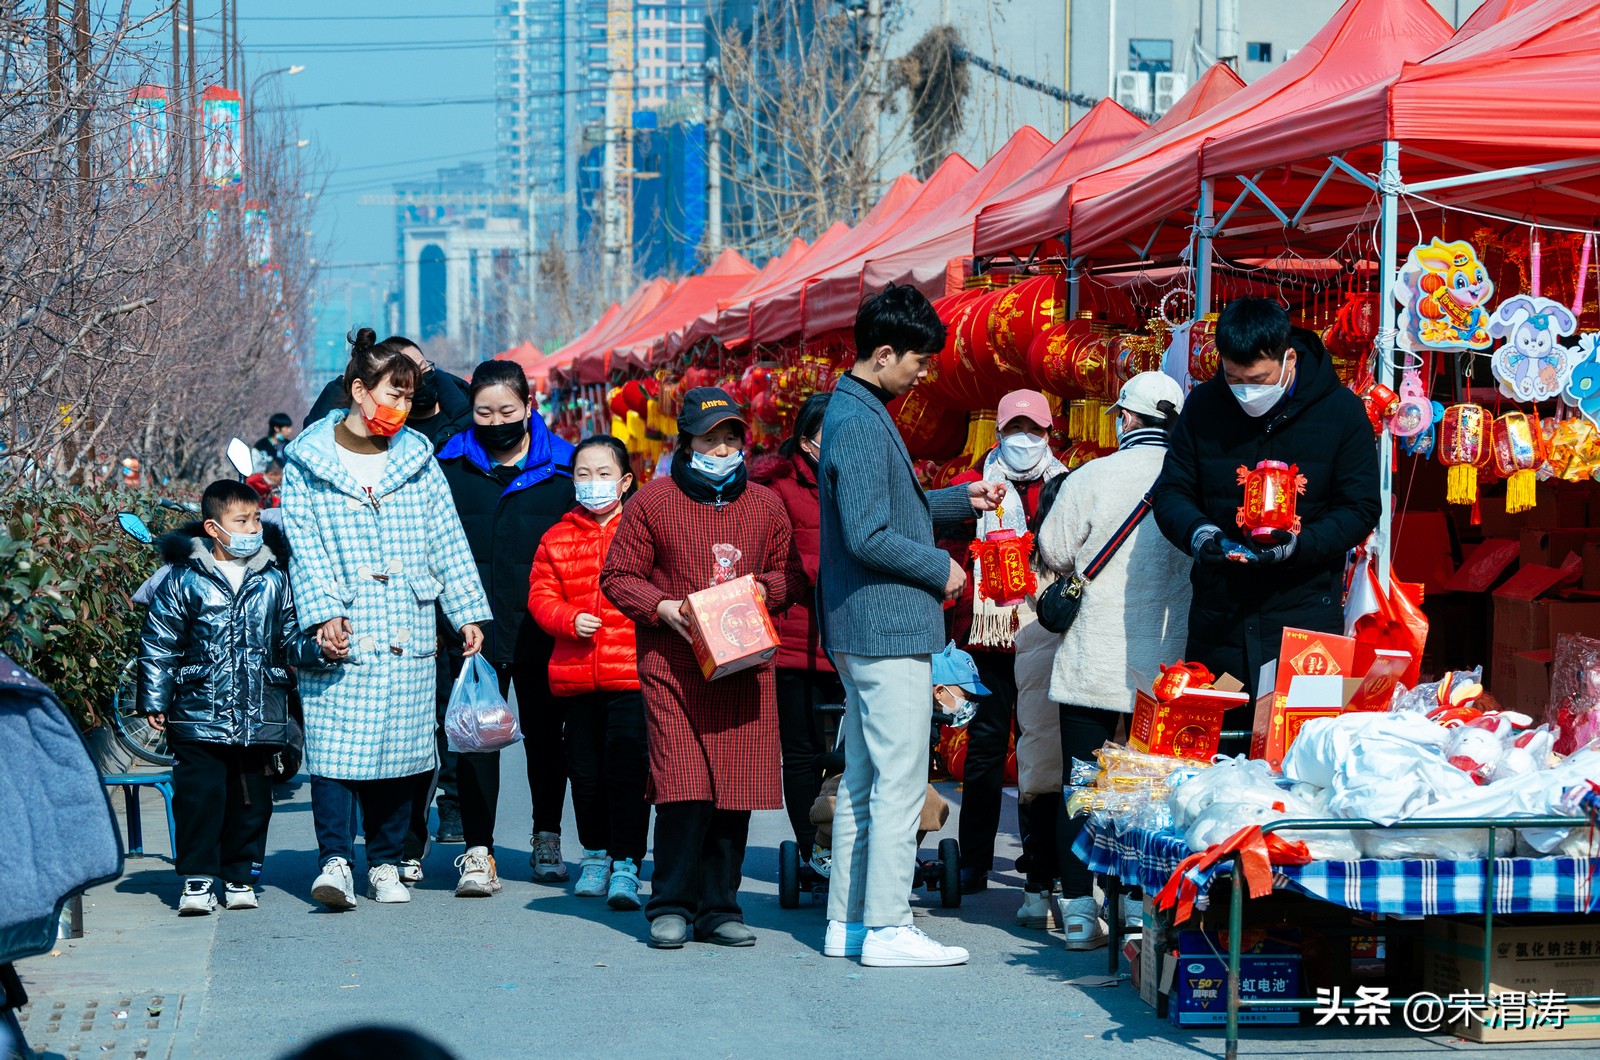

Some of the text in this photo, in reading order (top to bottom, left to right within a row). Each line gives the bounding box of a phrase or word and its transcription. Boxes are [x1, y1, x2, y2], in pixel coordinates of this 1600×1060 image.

[701, 400, 728, 410] Anran
[1249, 481, 1259, 514] 万事如意
[1008, 553, 1021, 585] 万事如意
[1198, 978, 1212, 989] 50
[1238, 978, 1286, 993] 虹电池
[1192, 989, 1218, 998] 周年庆
